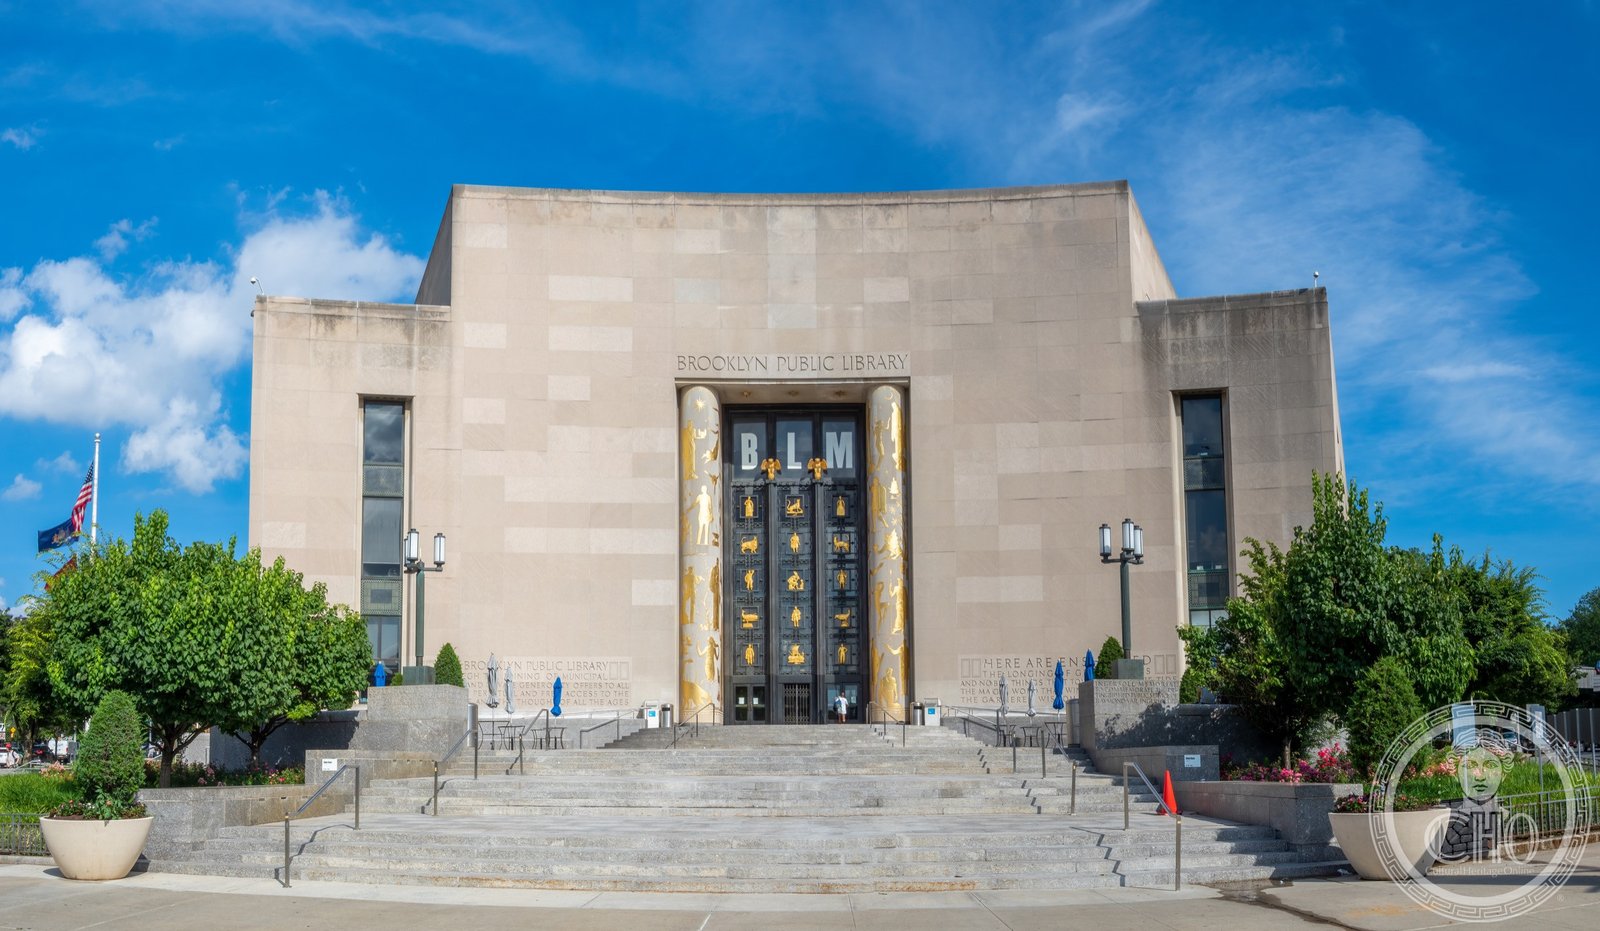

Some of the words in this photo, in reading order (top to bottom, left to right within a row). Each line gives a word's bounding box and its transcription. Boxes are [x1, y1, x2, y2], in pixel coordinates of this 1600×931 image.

[677, 355, 768, 371] BROOKLYN
[777, 355, 834, 371] PUBLIC
[842, 354, 908, 370] LIBRARY
[464, 660, 521, 671] BROKLYN
[526, 660, 562, 671] PUBLIC
[567, 660, 608, 671] LIBRARY
[983, 657, 1020, 668] HERE
[1026, 657, 1052, 668] ARE
[562, 672, 608, 681] MUNICIPAL
[982, 670, 1002, 678] THE
[1008, 669, 1053, 678] LONGING
[519, 681, 570, 689] GENEROTY
[573, 681, 603, 689] OFFERS
[605, 681, 615, 689] TO
[617, 681, 630, 689] ALL
[961, 679, 978, 687] AND
[514, 698, 552, 706] THOUGH
[574, 698, 587, 706] ALL
[589, 698, 605, 706] THE
[607, 698, 629, 706] AGES
